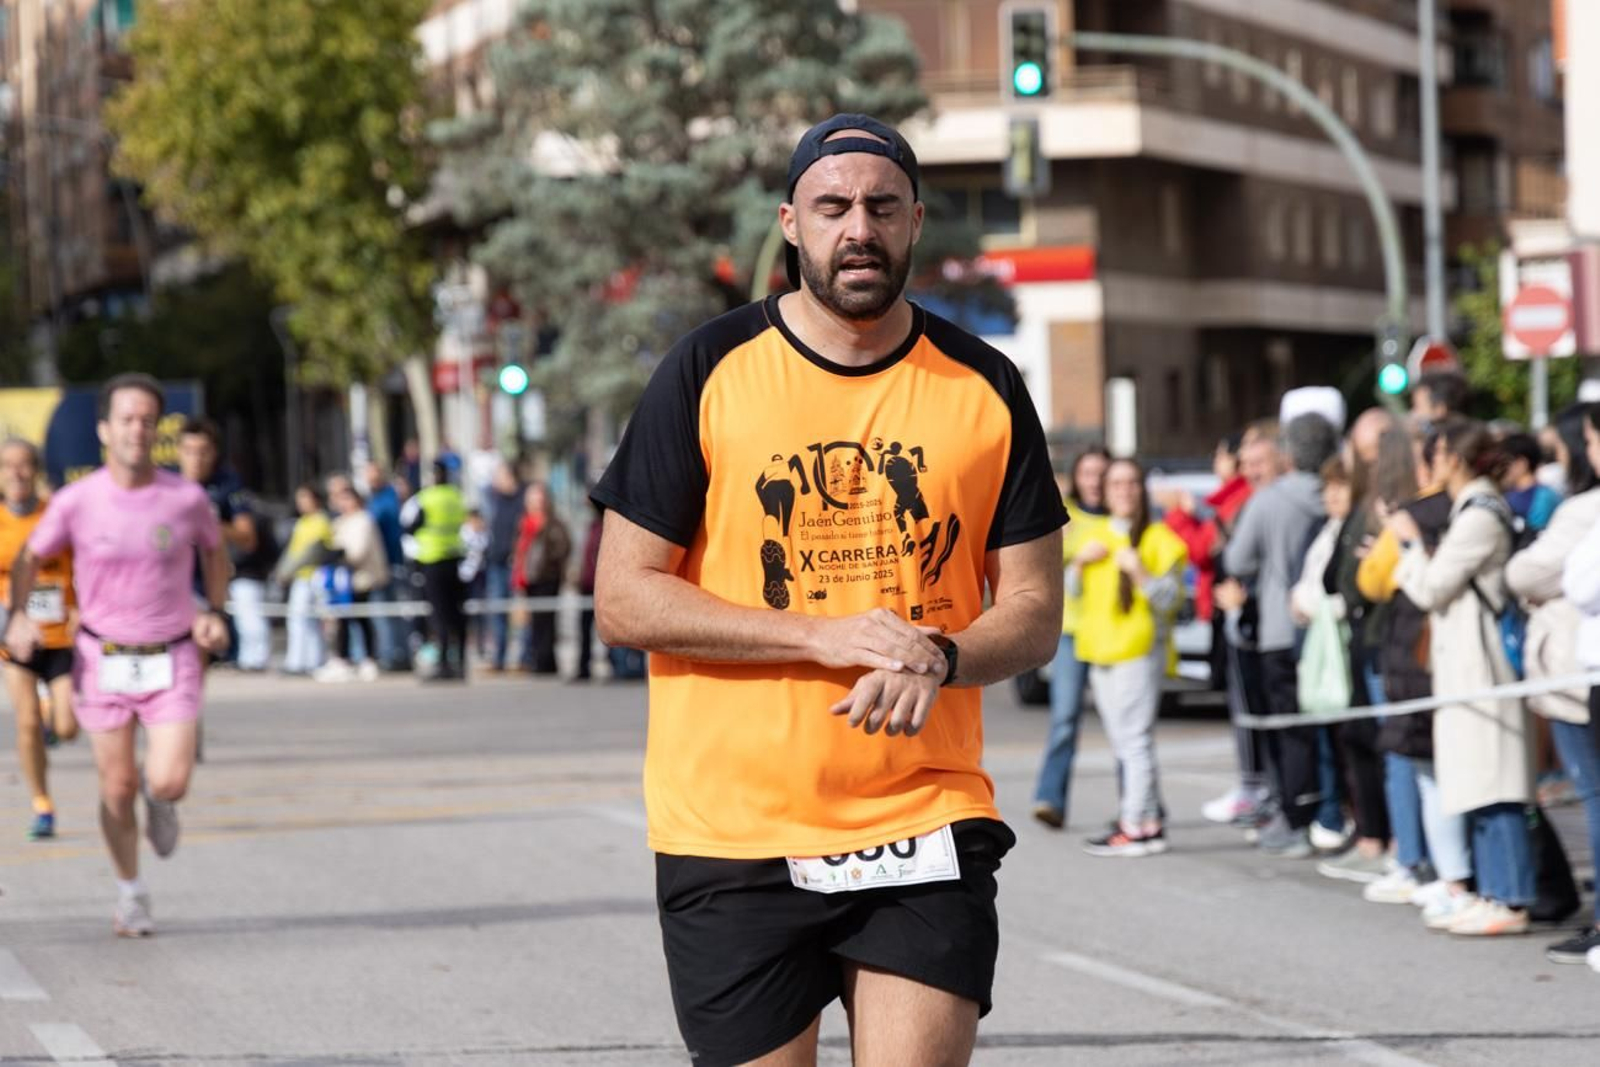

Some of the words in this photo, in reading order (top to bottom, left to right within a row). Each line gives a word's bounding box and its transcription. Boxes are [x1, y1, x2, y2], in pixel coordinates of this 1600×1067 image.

[799, 510, 892, 528] JaénGenuino
[800, 530, 809, 541] El
[799, 549, 815, 572] X
[818, 543, 898, 563] CARRERA
[862, 559, 878, 568] SAN
[879, 557, 899, 567] JUAN
[819, 574, 830, 583] 23
[833, 573, 844, 582] de
[846, 571, 871, 583] Junio
[873, 569, 894, 580] 2025
